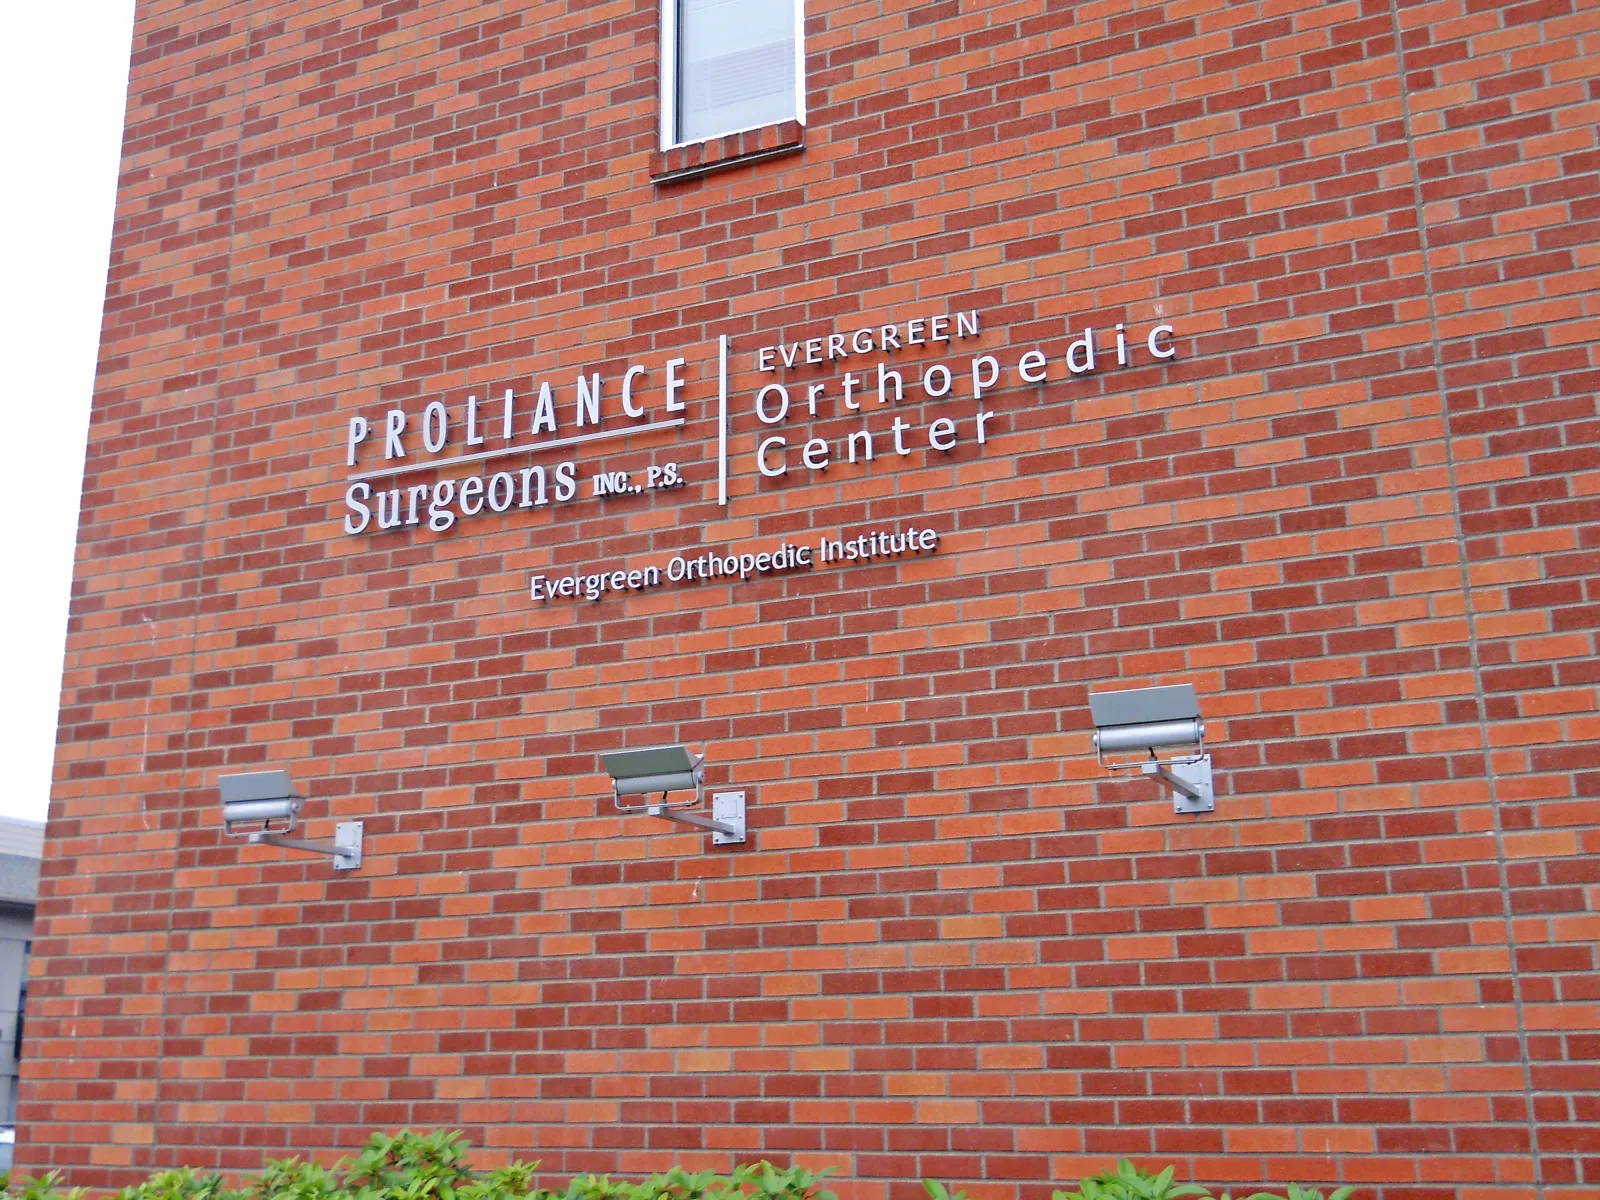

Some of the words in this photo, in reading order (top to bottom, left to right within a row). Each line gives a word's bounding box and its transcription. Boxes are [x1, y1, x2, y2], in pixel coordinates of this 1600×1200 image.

[756, 323, 1176, 425] Orthopedic
[758, 309, 981, 372] EVERGREEN
[347, 357, 686, 467] PROLIANCE
[757, 410, 994, 477] Center
[344, 461, 577, 535] Surgeons
[647, 462, 684, 489] P.S.
[530, 564, 659, 601] Evergreen
[667, 543, 811, 582] Orthopedic
[820, 526, 938, 562] Institute
